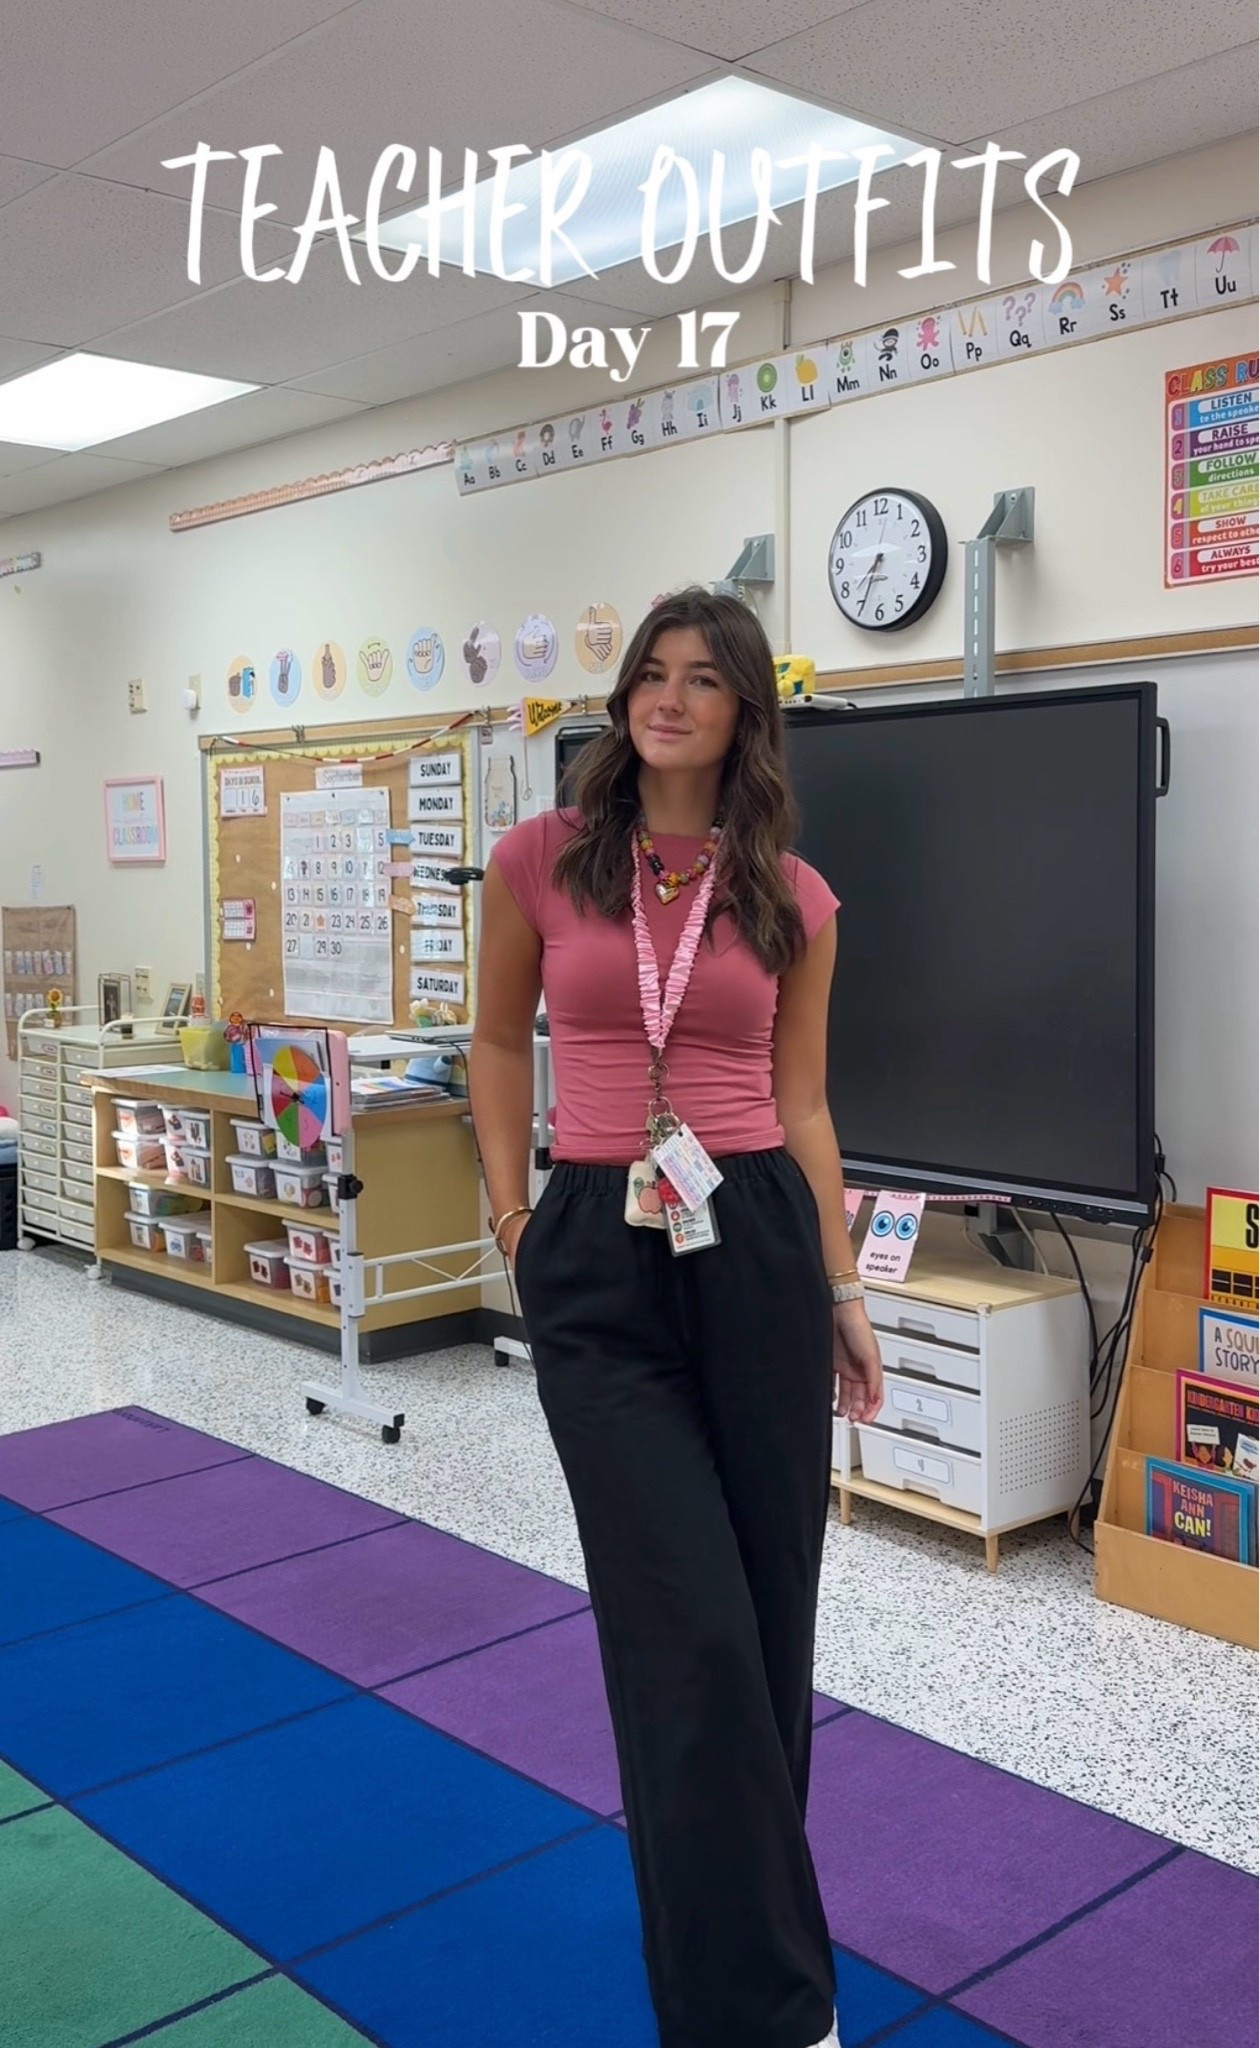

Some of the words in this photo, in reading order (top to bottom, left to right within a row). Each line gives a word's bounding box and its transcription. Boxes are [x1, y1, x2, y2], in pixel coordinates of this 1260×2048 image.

[515, 459, 527, 472] Cc
[543, 452, 555, 466] Dd
[572, 444, 584, 459] Ee
[601, 435, 614, 451] Ff
[631, 429, 645, 445] Gg
[662, 420, 678, 437] Hh
[697, 412, 708, 428] Ii
[732, 404, 742, 422] Jj
[760, 395, 777, 411] Kk
[801, 384, 814, 402] Ll
[837, 376, 860, 393] Mm
[879, 364, 898, 382] Nn
[920, 353, 940, 370] Oo
[966, 342, 983, 362] Pp
[1009, 330, 1033, 348] Qq
[1059, 317, 1078, 335] Rr
[1109, 303, 1126, 322] Ss
[1160, 287, 1179, 309] Tt
[1215, 275, 1237, 295] Uu
[1167, 364, 1228, 398] CLASS
[1210, 392, 1252, 410] LISTEN
[1200, 414, 1210, 424] to
[1211, 411, 1226, 421] the
[1211, 423, 1249, 440] RAISE
[1174, 440, 1183, 454] 2
[1193, 445, 1212, 456] your
[1213, 439, 1234, 451] hand
[1235, 438, 1244, 447] to
[1206, 452, 1257, 471] FOLLOW
[1208, 467, 1255, 482] directions
[873, 498, 889, 516] 12
[896, 503, 903, 520] 1
[1173, 498, 1183, 514] 4
[856, 510, 867, 528] 11
[1215, 516, 1247, 529] SHOW
[911, 519, 921, 538] 2
[840, 530, 853, 549] 10
[1192, 532, 1227, 545] respect
[1228, 530, 1239, 539] to
[917, 545, 927, 563] 3
[1210, 545, 1251, 560] ALWAYS
[835, 557, 844, 576] 9
[1174, 557, 1182, 573] 6
[1201, 564, 1217, 574] try
[1217, 561, 1239, 571] your
[910, 572, 921, 589] 4
[840, 581, 850, 599] 8
[856, 600, 865, 617] 7
[895, 594, 904, 612] 5
[875, 603, 885, 621] 6
[528, 701, 562, 727] Welcome
[420, 762, 451, 777] SUNDAY
[419, 797, 453, 811] MONDAY
[330, 834, 337, 848] 2
[345, 833, 352, 848] 3
[378, 832, 384, 847] 5
[418, 832, 455, 847] TUESDAY
[315, 861, 321, 875] 8
[330, 861, 337, 875] 9
[345, 860, 353, 874] 10
[288, 888, 296, 901] 13
[346, 887, 354, 901] 17
[286, 912, 297, 926] 20
[331, 914, 341, 928] 23
[345, 915, 355, 928] 24
[360, 915, 370, 929] 25
[377, 916, 388, 930] 26
[286, 939, 297, 953] 27
[317, 940, 327, 953] 29
[330, 941, 342, 955] 30
[417, 977, 459, 994] SATURDAY
[870, 1251, 889, 1261] eyes
[890, 1253, 901, 1262] on
[865, 1262, 898, 1274] speaker
[1215, 1326, 1222, 1343] A
[1215, 1347, 1259, 1374] STORY
[916, 1398, 923, 1412] 2
[1173, 1481, 1213, 1507] KEISHA
[1180, 1499, 1205, 1519] ANN
[1174, 1511, 1211, 1537] CAN!
